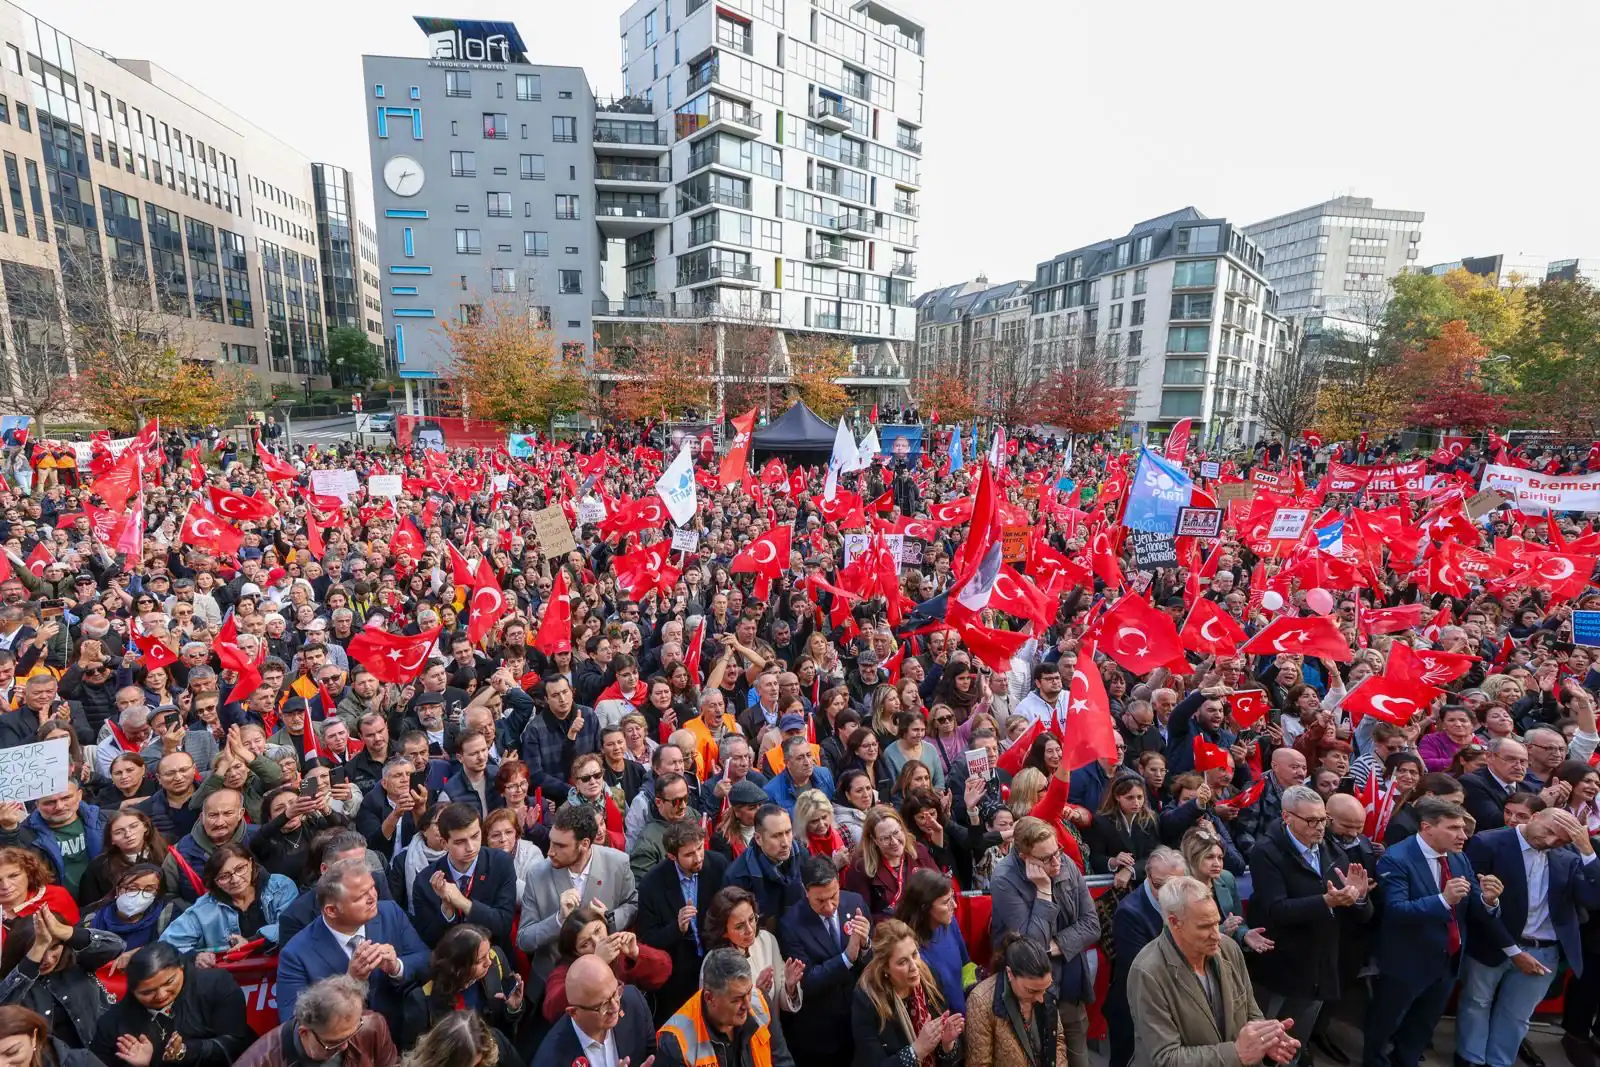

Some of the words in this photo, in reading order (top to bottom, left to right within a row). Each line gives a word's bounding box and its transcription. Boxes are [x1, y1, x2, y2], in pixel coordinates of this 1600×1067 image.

[430, 29, 509, 62] aloft
[1256, 473, 1277, 483] CHP
[1528, 478, 1600, 491] Bremen
[1330, 481, 1356, 490] CHP
[1459, 561, 1490, 572] CHP
[0, 744, 44, 764] ZGÜR
[0, 777, 54, 801] REM!
